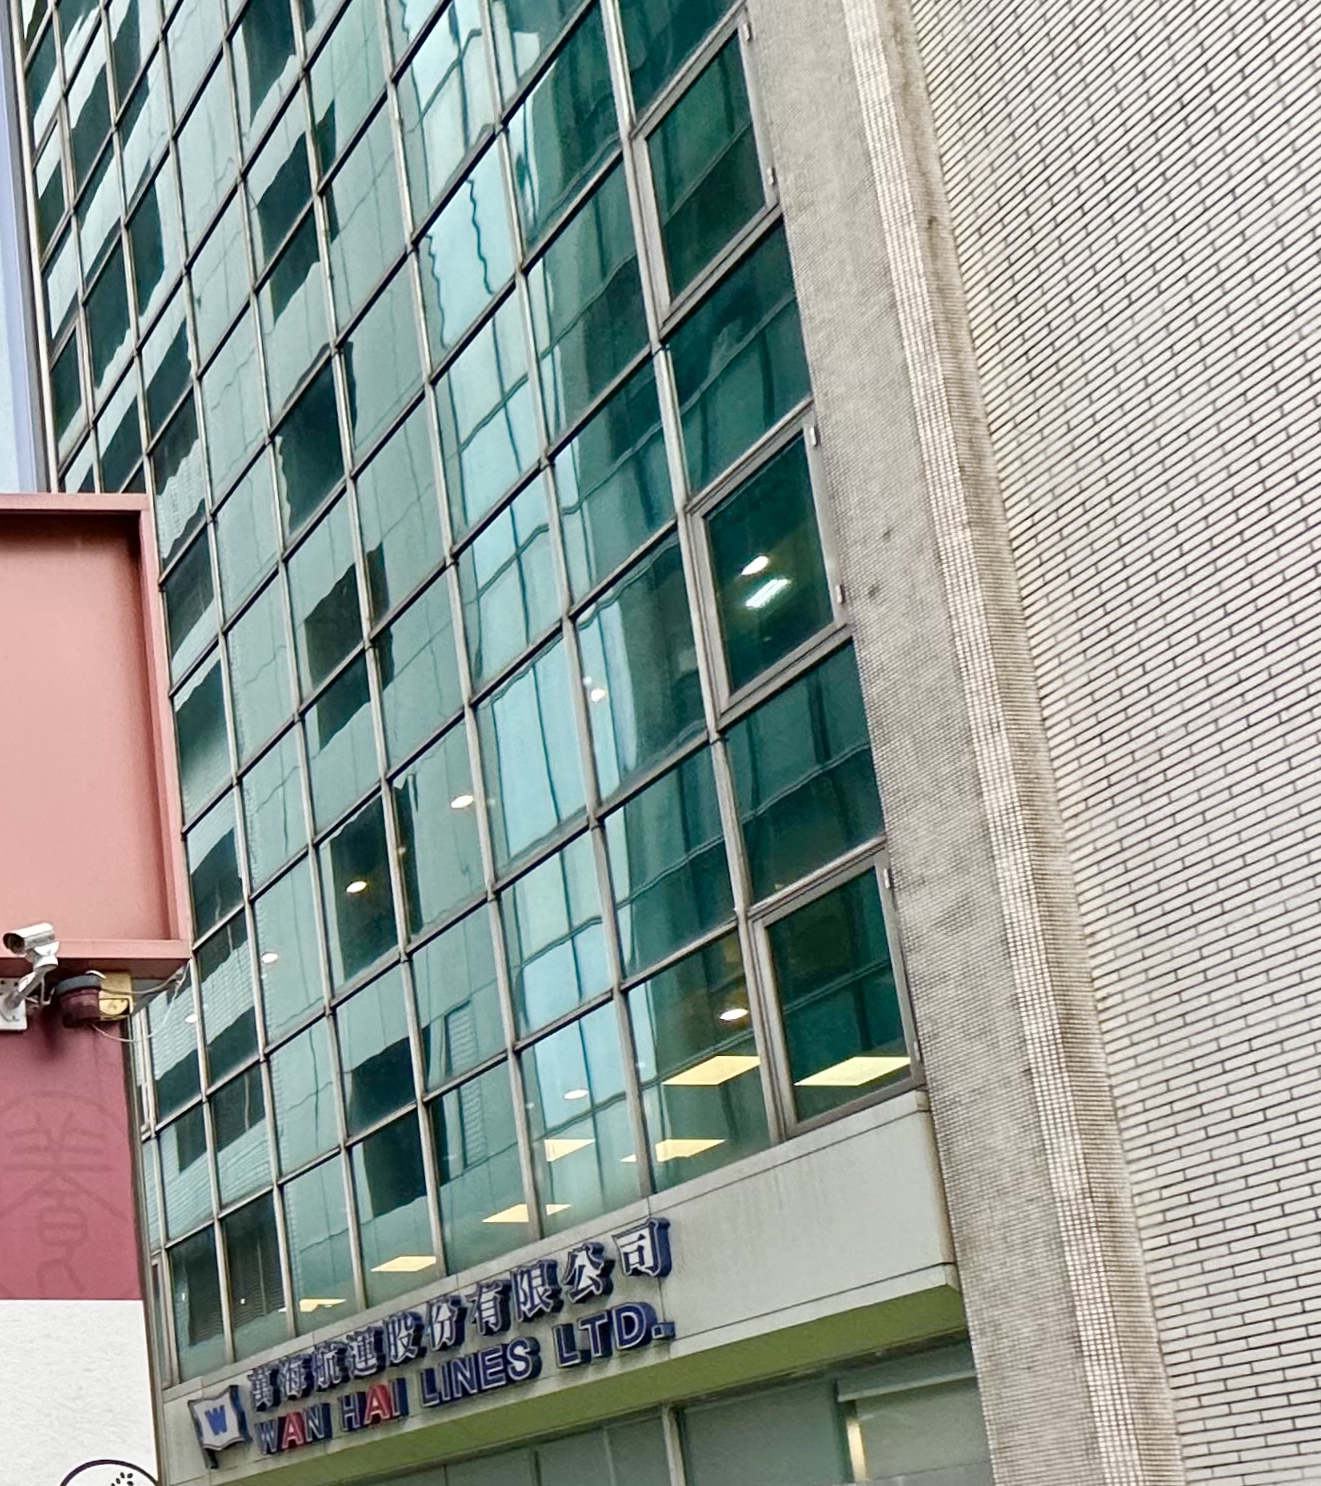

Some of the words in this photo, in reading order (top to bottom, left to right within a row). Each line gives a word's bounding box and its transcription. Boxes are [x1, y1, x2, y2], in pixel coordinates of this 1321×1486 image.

[256, 1401, 332, 1455] WAN
[338, 1377, 409, 1432] HAI
[420, 1337, 541, 1409] LINES
[552, 1302, 675, 1368] LTD.
